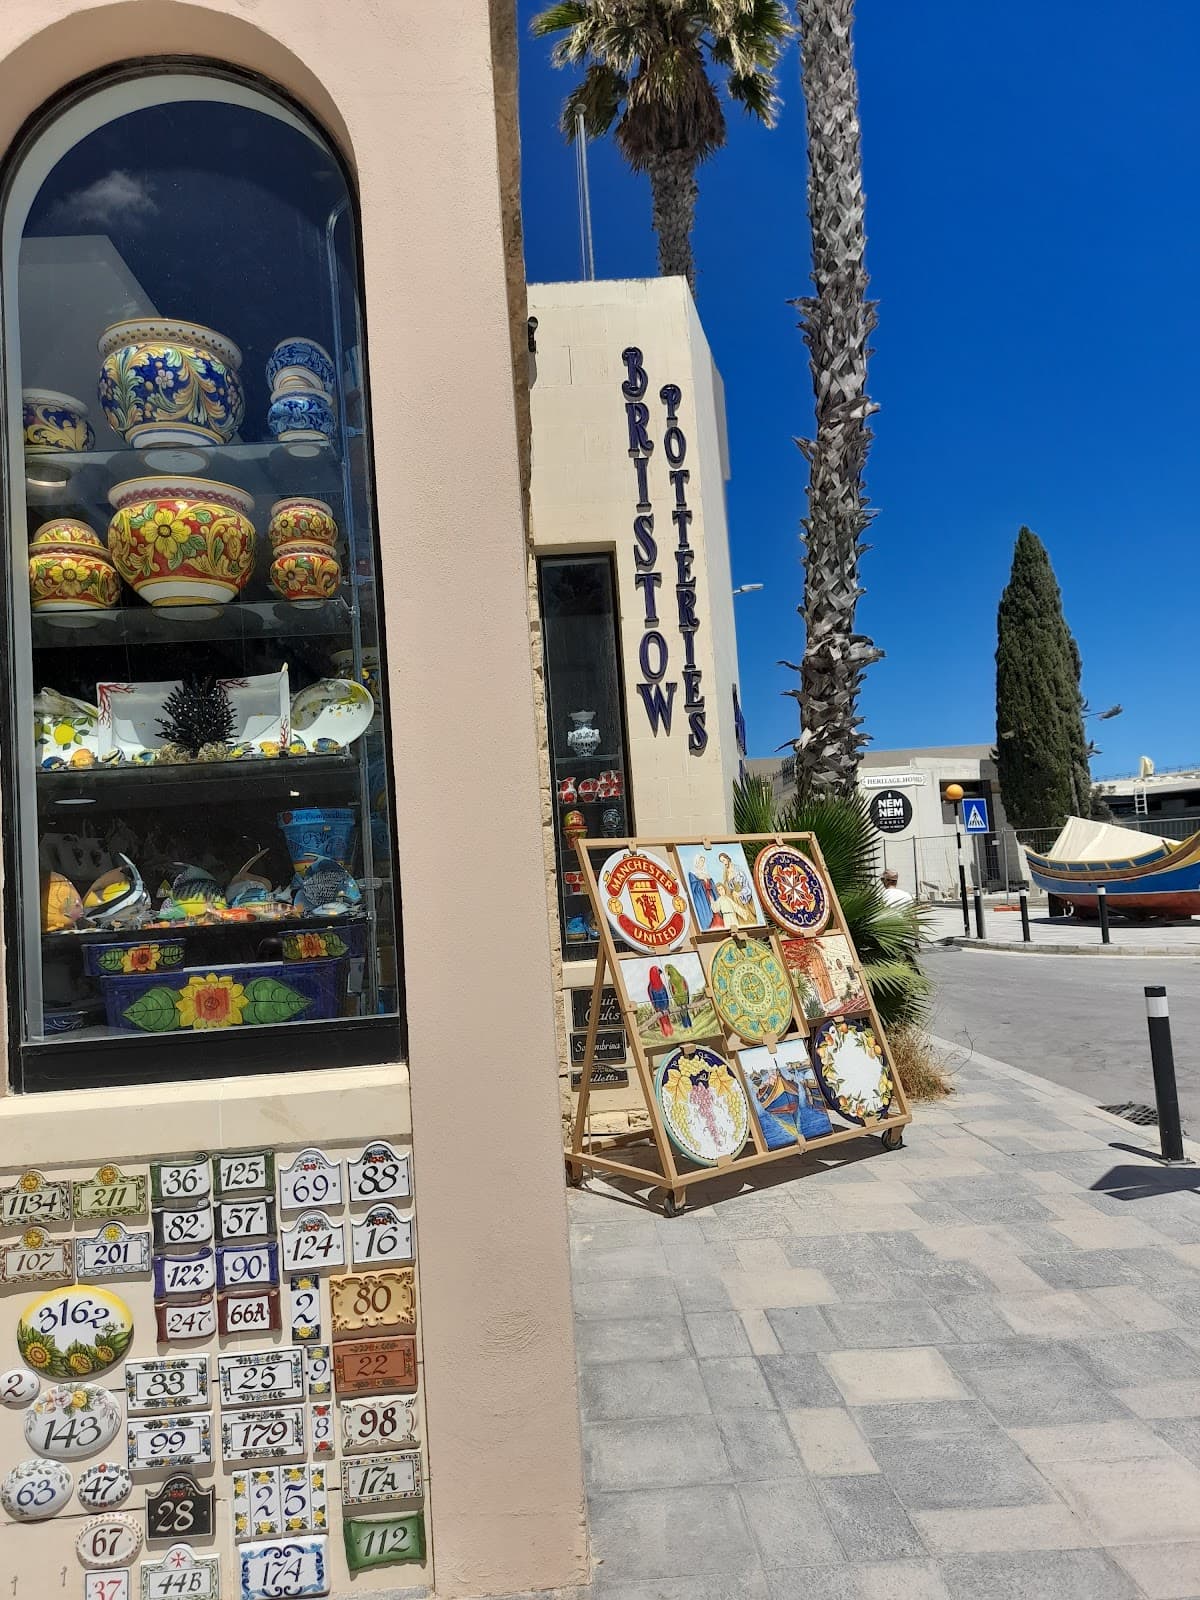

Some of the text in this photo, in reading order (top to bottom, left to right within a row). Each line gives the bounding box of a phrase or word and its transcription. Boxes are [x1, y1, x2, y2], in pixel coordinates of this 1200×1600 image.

[622, 347, 677, 737] BRISTOW
[660, 384, 708, 753] POTTERIES
[878, 799, 903, 808] NEM
[879, 808, 904, 817] NEM
[611, 860, 673, 891] MANCHESTER
[633, 926, 677, 943] UNITED
[166, 1168, 198, 1195] 36
[224, 1162, 260, 1187] 125
[293, 1174, 329, 1202] 69
[358, 1164, 400, 1195] 88
[8, 1192, 58, 1216] 1134
[90, 1187, 127, 1207] 211
[168, 1214, 199, 1241] 82
[226, 1206, 260, 1234] 57
[93, 1243, 129, 1266] 201
[292, 1233, 334, 1261] 124
[365, 1226, 399, 1257] 16
[16, 1252, 55, 1272] 107
[169, 1263, 205, 1287] 122
[229, 1255, 262, 1282] 90
[230, 1302, 266, 1324] 66A
[293, 1293, 315, 1324] 2
[353, 1284, 392, 1316] 80
[39, 1298, 110, 1334] 3162
[169, 1309, 211, 1333] 247
[238, 1365, 279, 1390] 25
[310, 1359, 328, 1381] 9
[356, 1355, 388, 1376] 22
[3, 1373, 26, 1398] 2
[146, 1371, 185, 1397] 33
[44, 1416, 102, 1449] 143
[242, 1421, 288, 1447] 179
[314, 1417, 329, 1438] 8
[358, 1407, 397, 1438] 98
[150, 1431, 186, 1454] 99
[16, 1479, 57, 1506] 63
[84, 1476, 119, 1500] 47
[359, 1466, 400, 1495] 17A
[255, 1484, 307, 1517] 25
[156, 1500, 194, 1532] 28
[92, 1527, 124, 1557] 67
[364, 1526, 410, 1557] 112
[158, 1572, 202, 1595] 44B
[262, 1557, 304, 1586] 174
[94, 1580, 122, 1600] 37
